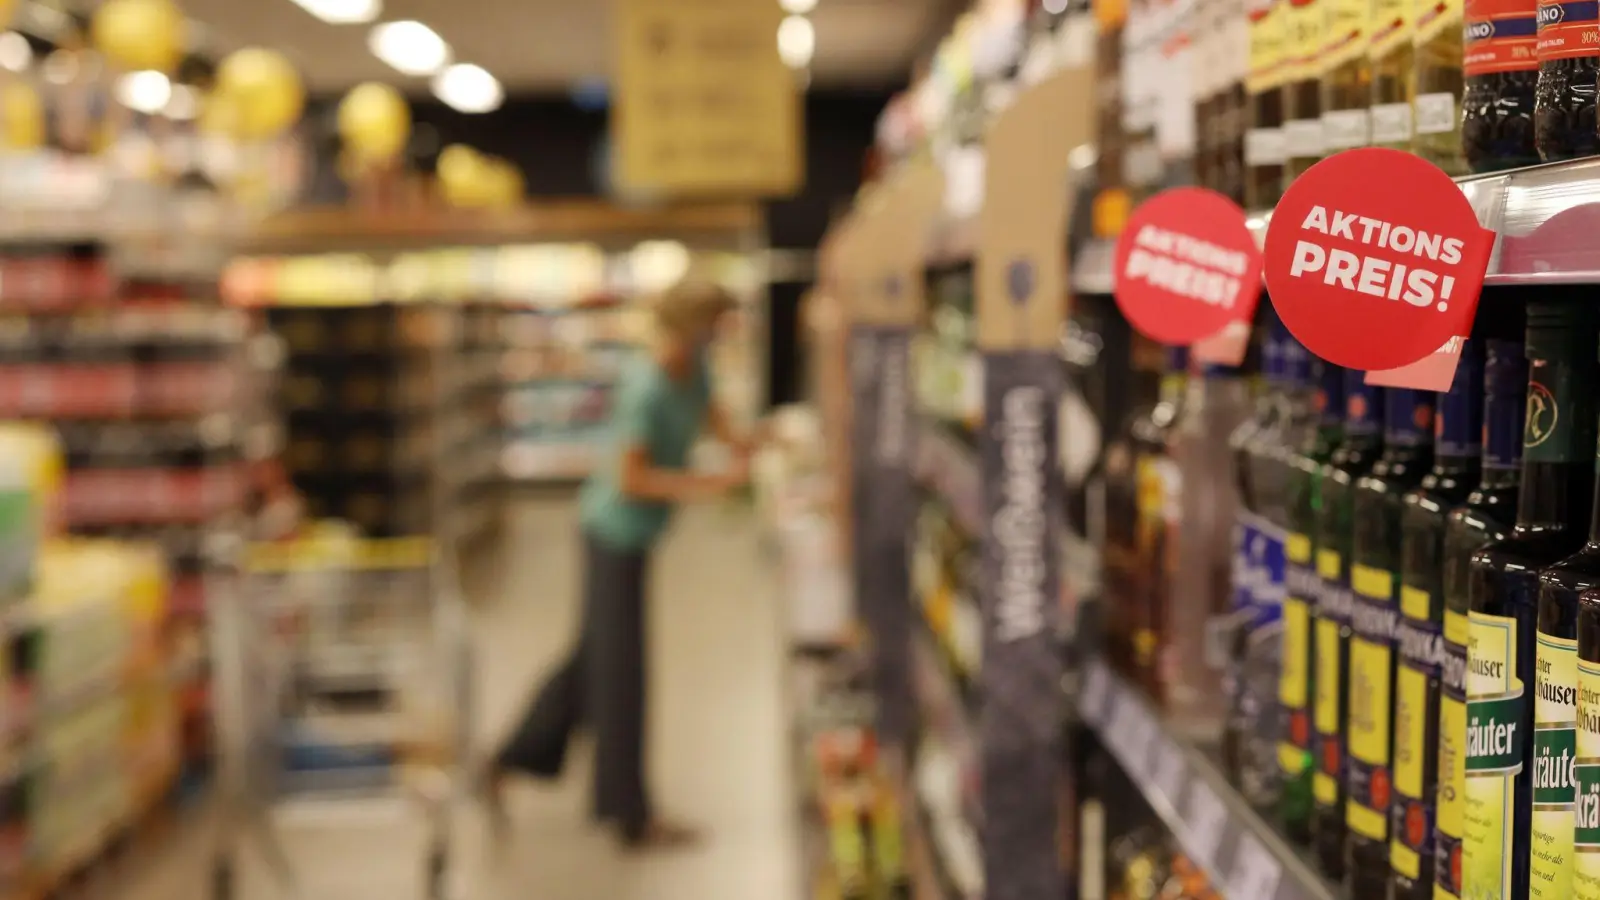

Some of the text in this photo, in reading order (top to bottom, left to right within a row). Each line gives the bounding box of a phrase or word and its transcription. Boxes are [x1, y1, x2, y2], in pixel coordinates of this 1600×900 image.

[1134, 224, 1247, 276] AKTIONS
[1301, 205, 1464, 265] AKTIONS
[1125, 248, 1240, 310] PREIS!
[1290, 240, 1456, 312] PREIS!
[994, 386, 1045, 643] Weißwein
